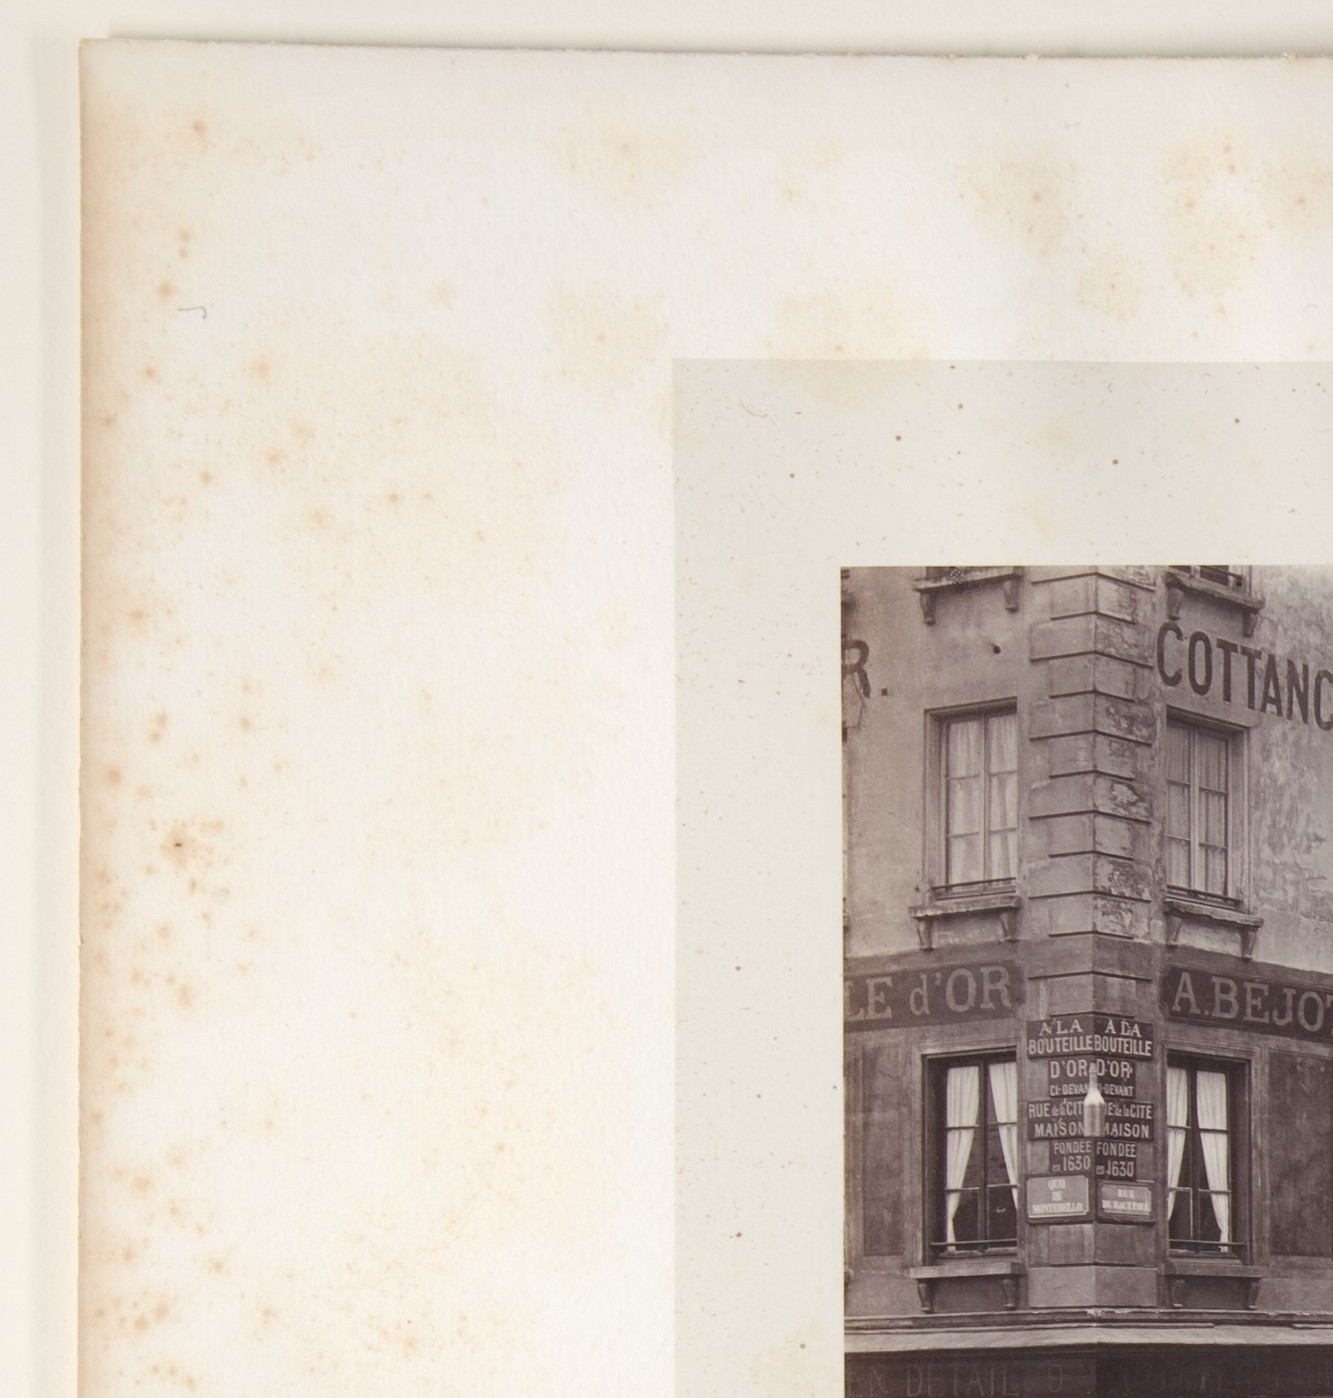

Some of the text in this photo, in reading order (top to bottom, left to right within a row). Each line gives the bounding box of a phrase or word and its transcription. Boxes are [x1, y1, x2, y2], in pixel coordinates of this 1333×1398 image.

[909, 965, 1013, 1017] d'OR
[1056, 1019, 1083, 1035] LA
[1121, 1020, 1142, 1038] LA
[1028, 1035, 1094, 1055] BOUTEILLE
[1094, 1034, 1153, 1056] BOUTEILLE
[1050, 1059, 1089, 1079] D'OR
[1096, 1058, 1133, 1079] D'OR
[1050, 1083, 1090, 1097] CI-DEVAN
[1028, 1102, 1051, 1119] RUE
[1066, 1101, 1084, 1116] CIT
[1062, 1155, 1092, 1172] 1630
[1106, 1160, 1135, 1177] 1630
